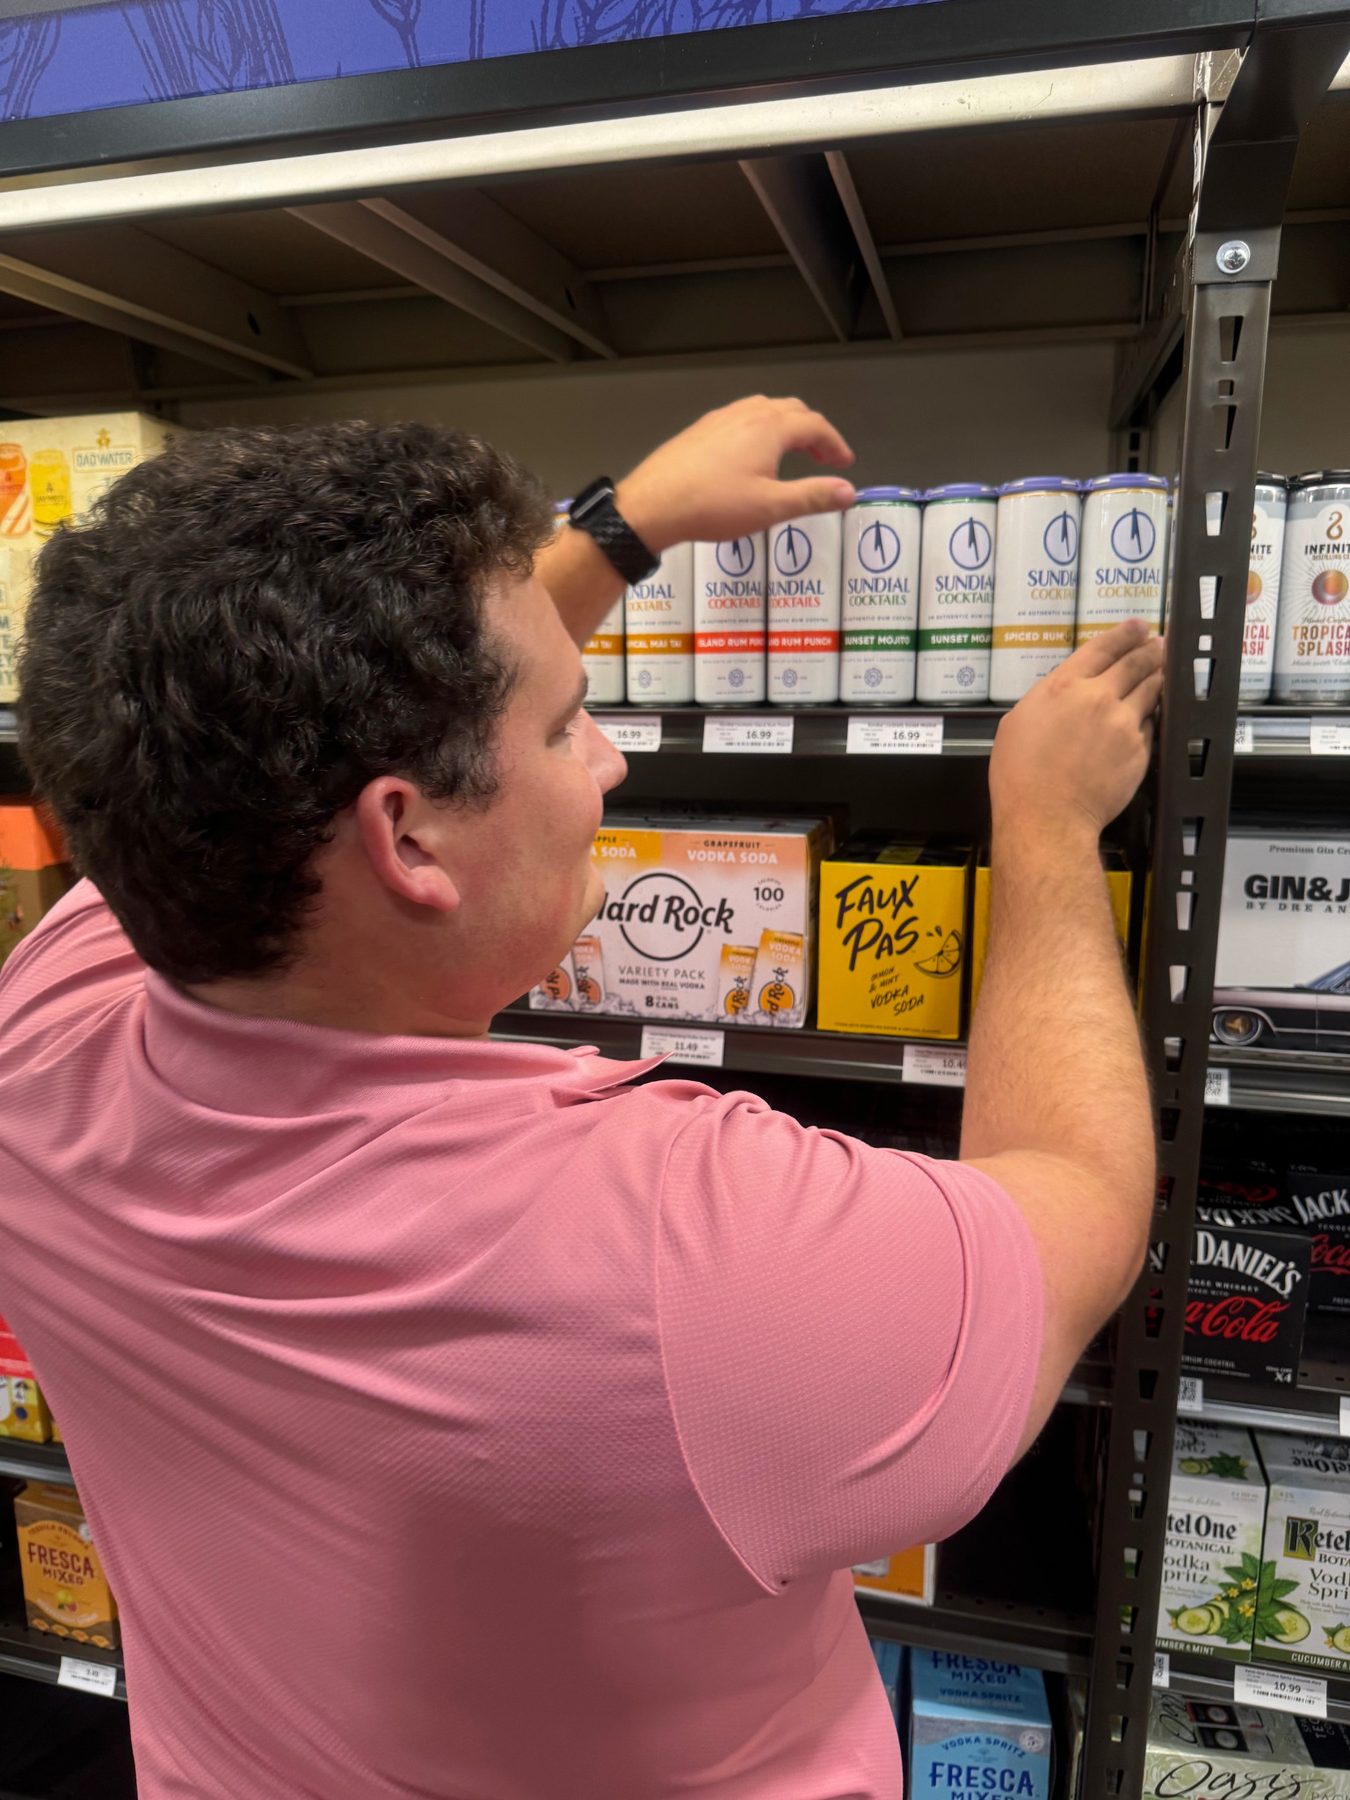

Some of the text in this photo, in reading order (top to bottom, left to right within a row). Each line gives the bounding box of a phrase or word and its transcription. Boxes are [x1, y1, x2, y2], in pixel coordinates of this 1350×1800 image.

[1095, 567, 1161, 585] SUNDIAL
[847, 577, 911, 594] SUNDIAL
[1097, 585, 1159, 598] COCKTAILS
[848, 594, 906, 607] COCKTAILS
[781, 637, 801, 646] RUM
[804, 637, 832, 646] PUNCH
[931, 634, 969, 644] SUNSET
[1004, 631, 1064, 641] SPICED RUM
[1297, 641, 1350, 656] SPLASH
[617, 730, 641, 740] 16.99
[745, 730, 772, 740] 16.99
[892, 731, 920, 741] 16.99
[704, 840, 760, 850] GRAPEFRUIT
[1269, 844, 1314, 854] Premium
[1317, 846, 1335, 855] Gin
[601, 846, 637, 859] SODA
[687, 849, 778, 865] VODKA SODA
[753, 887, 785, 902] 100
[1246, 901, 1266, 909] BY
[1279, 902, 1313, 912] DRE
[663, 895, 735, 934] Rock
[618, 966, 705, 980] VARIETY PACK
[679, 981, 705, 990] VODKA
[880, 974, 900, 988] MINT
[645, 995, 654, 1007] 8
[656, 1002, 679, 1010] CANS
[871, 985, 909, 1009] VODKA
[893, 995, 925, 1016] SODA
[1291, 1188, 1350, 1226] JACK
[1196, 1230, 1303, 1296] DANIEL'S
[1215, 1281, 1259, 1293] WHISKEY
[1274, 1371, 1292, 1384] X4
[1194, 1514, 1237, 1540] One
[27, 1541, 95, 1579] FRESCA
[1164, 1554, 1210, 1571] odka
[42, 1567, 84, 1585] MIXED
[1164, 1569, 1208, 1584] pritz
[1193, 1646, 1215, 1656] MINT
[1291, 1652, 1340, 1669] CUCUMBER
[952, 1671, 1007, 1685] MIXED
[1274, 1681, 1302, 1693] 10.99
[940, 1687, 1021, 1703] VODKA SPRITZ
[942, 1736, 1026, 1759] VODKA SPRITZ
[929, 1762, 1034, 1797] FRESCA
